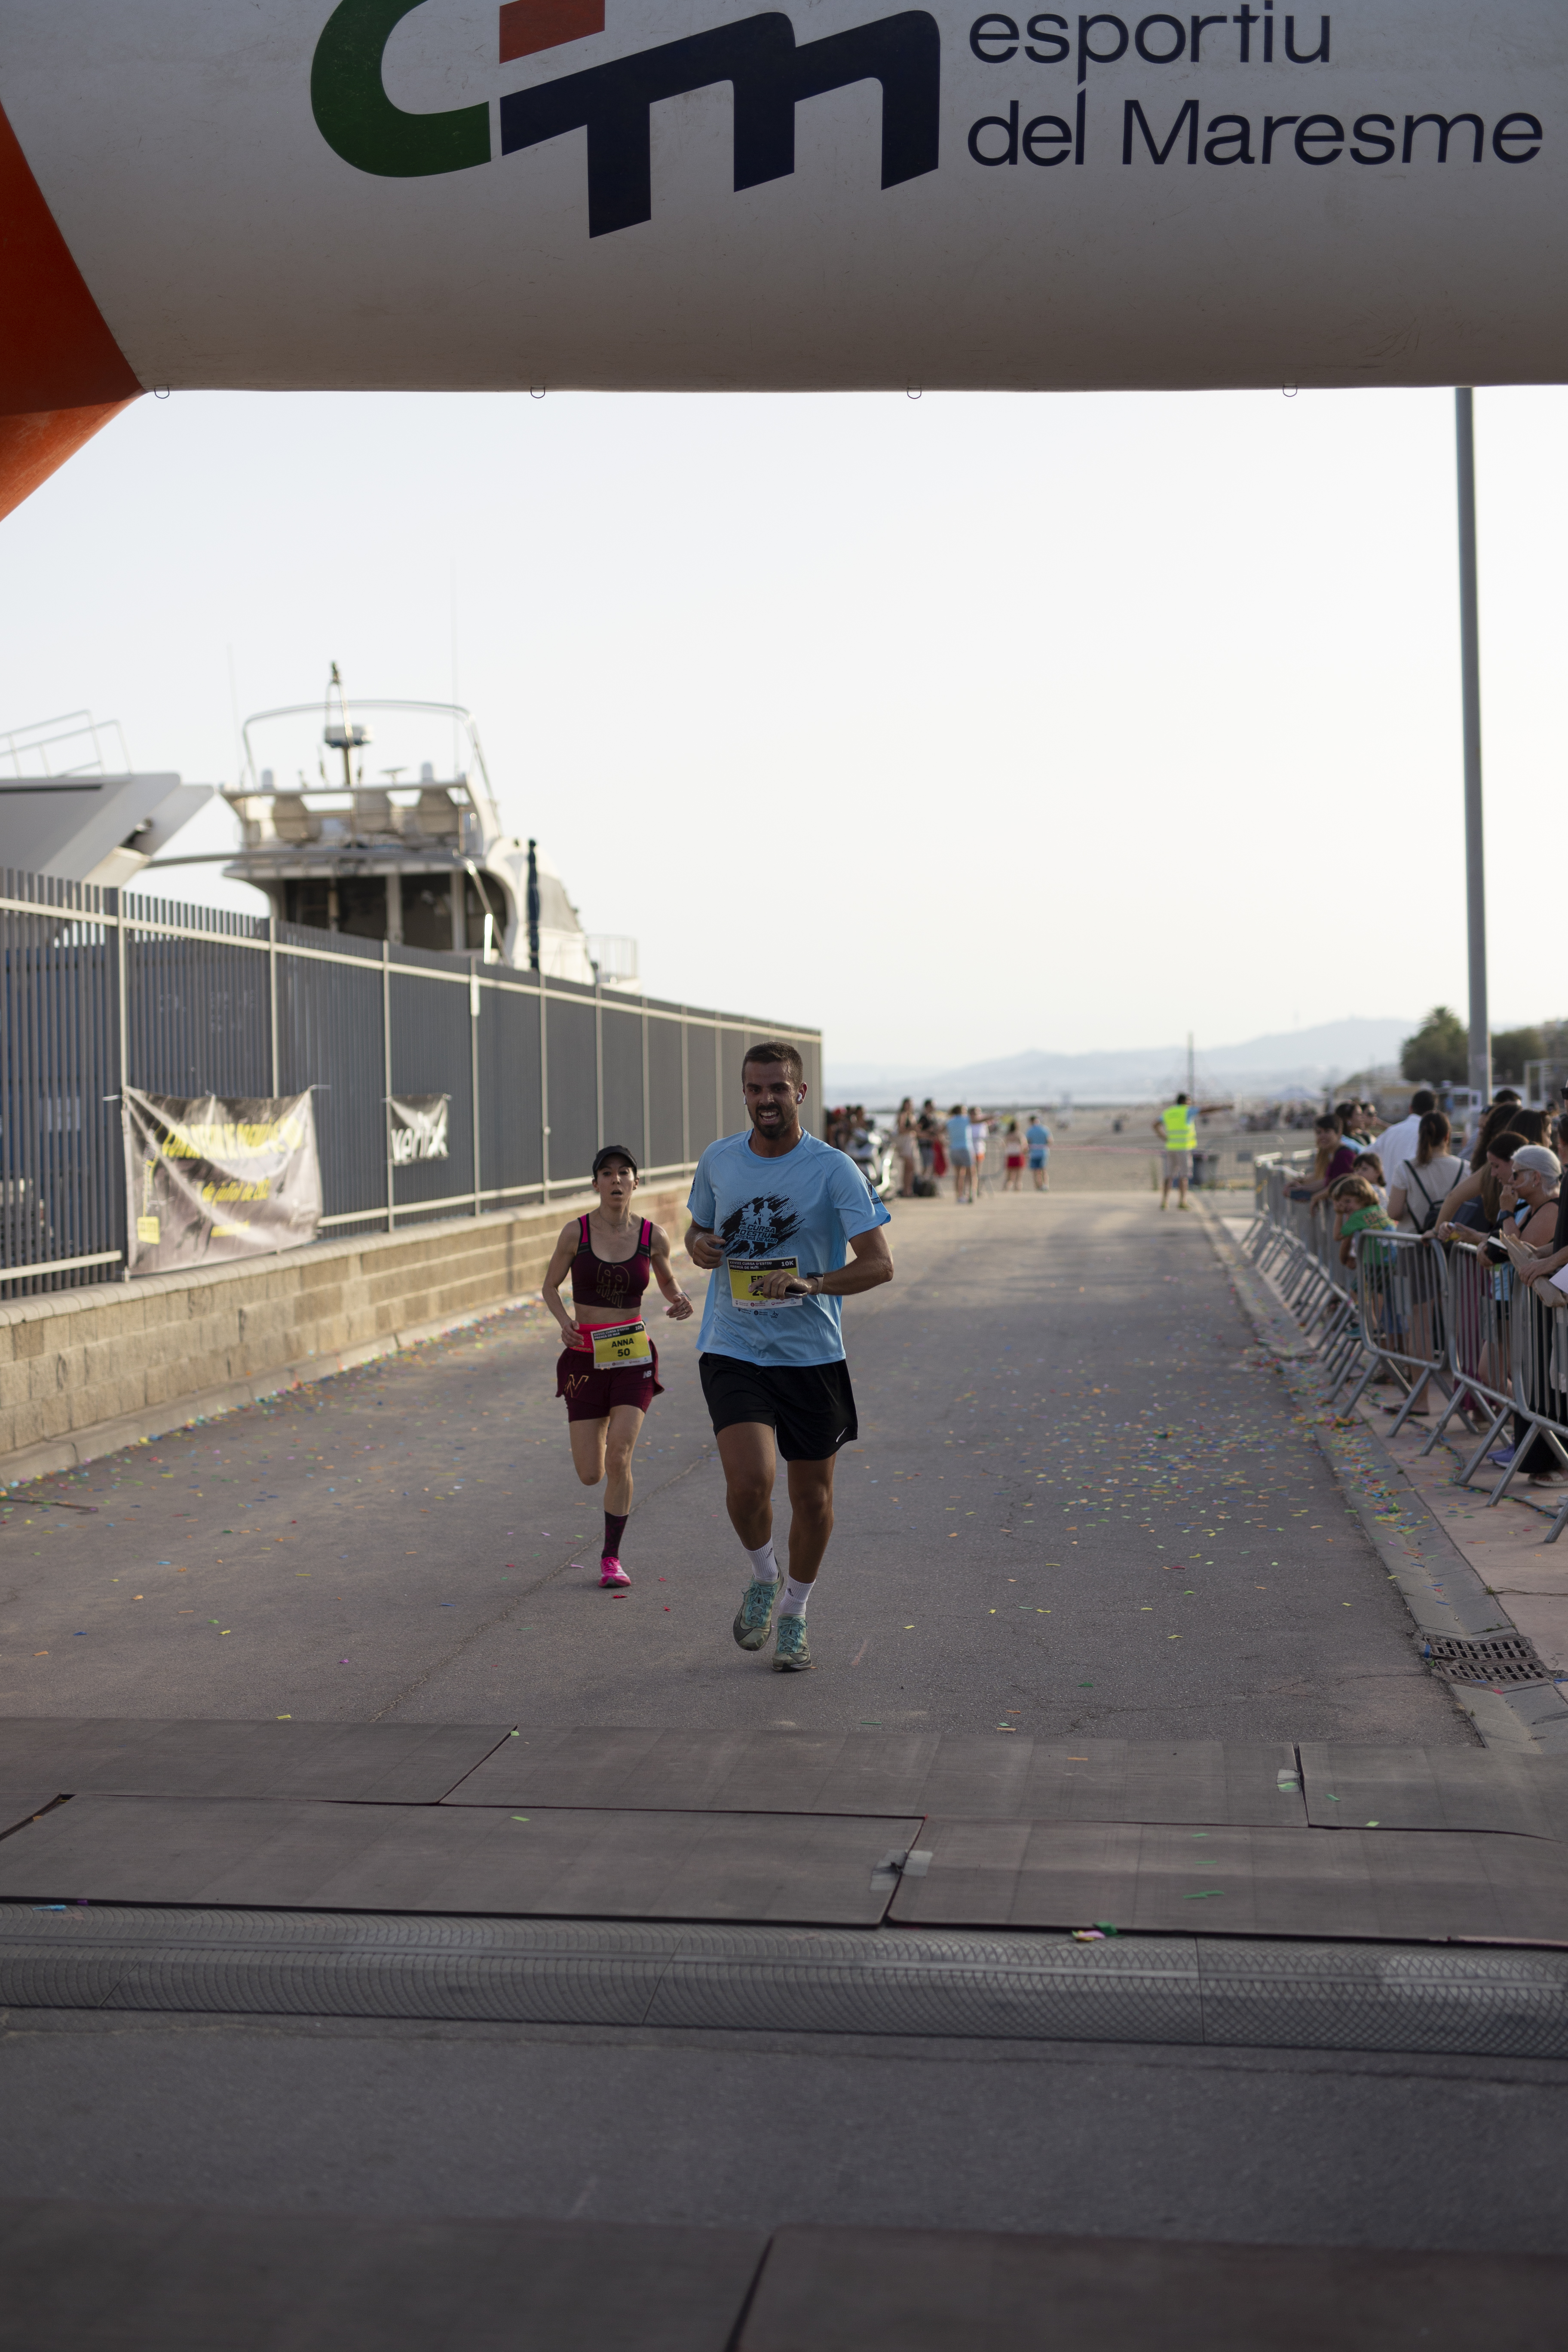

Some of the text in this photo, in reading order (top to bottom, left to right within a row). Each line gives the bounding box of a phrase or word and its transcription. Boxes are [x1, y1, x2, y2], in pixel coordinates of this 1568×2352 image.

[968, 0, 1331, 86] esportiu
[967, 88, 1544, 167] del Maresme
[739, 1229, 771, 1238] D'ESTIU
[747, 1224, 775, 1234] CURSA
[611, 1338, 634, 1348] ANNA
[617, 1348, 630, 1357] 50
